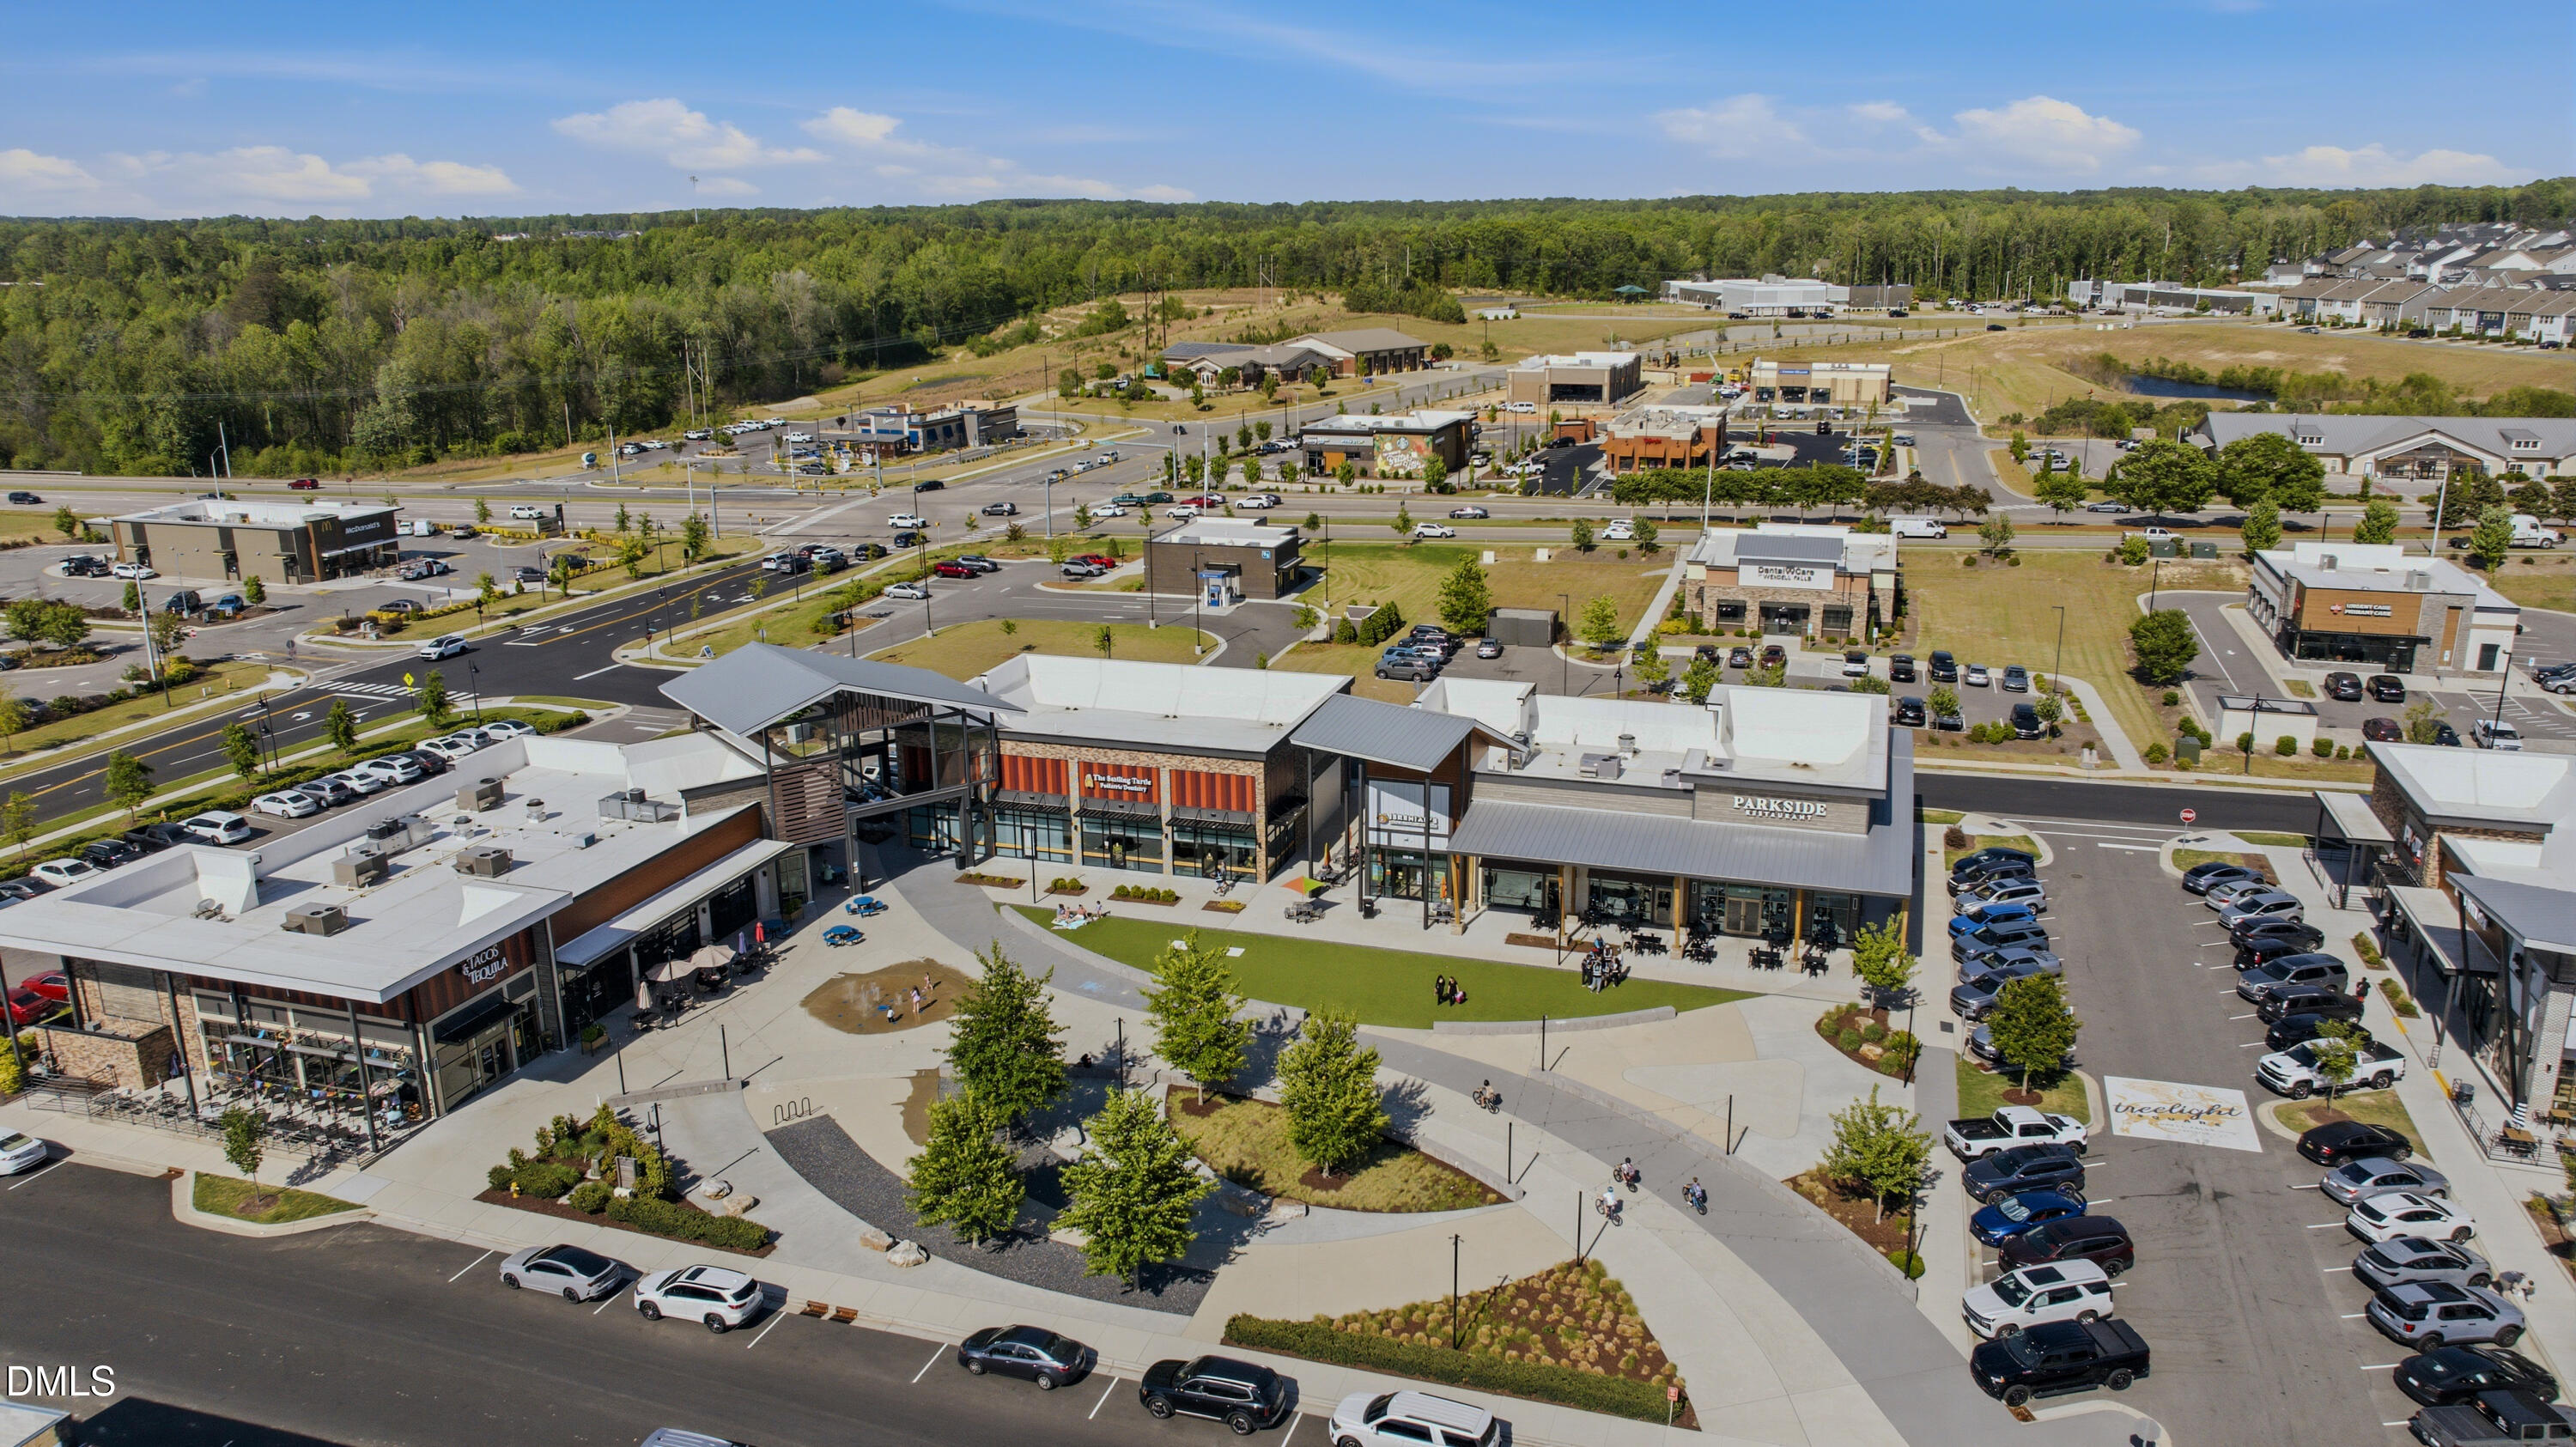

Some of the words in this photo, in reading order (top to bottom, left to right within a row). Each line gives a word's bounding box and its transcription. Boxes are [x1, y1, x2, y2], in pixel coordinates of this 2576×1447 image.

[345, 521, 380, 534] McDonald's
[1758, 566, 1785, 575] Dental
[1795, 568, 1814, 576] Care
[1733, 796, 1827, 817] PARKSIDE
[1745, 809, 1813, 821] RESTAURANT
[466, 944, 499, 970] TACOS
[468, 957, 508, 984] TEQUILA
[2112, 1103, 2244, 1120] treelight
